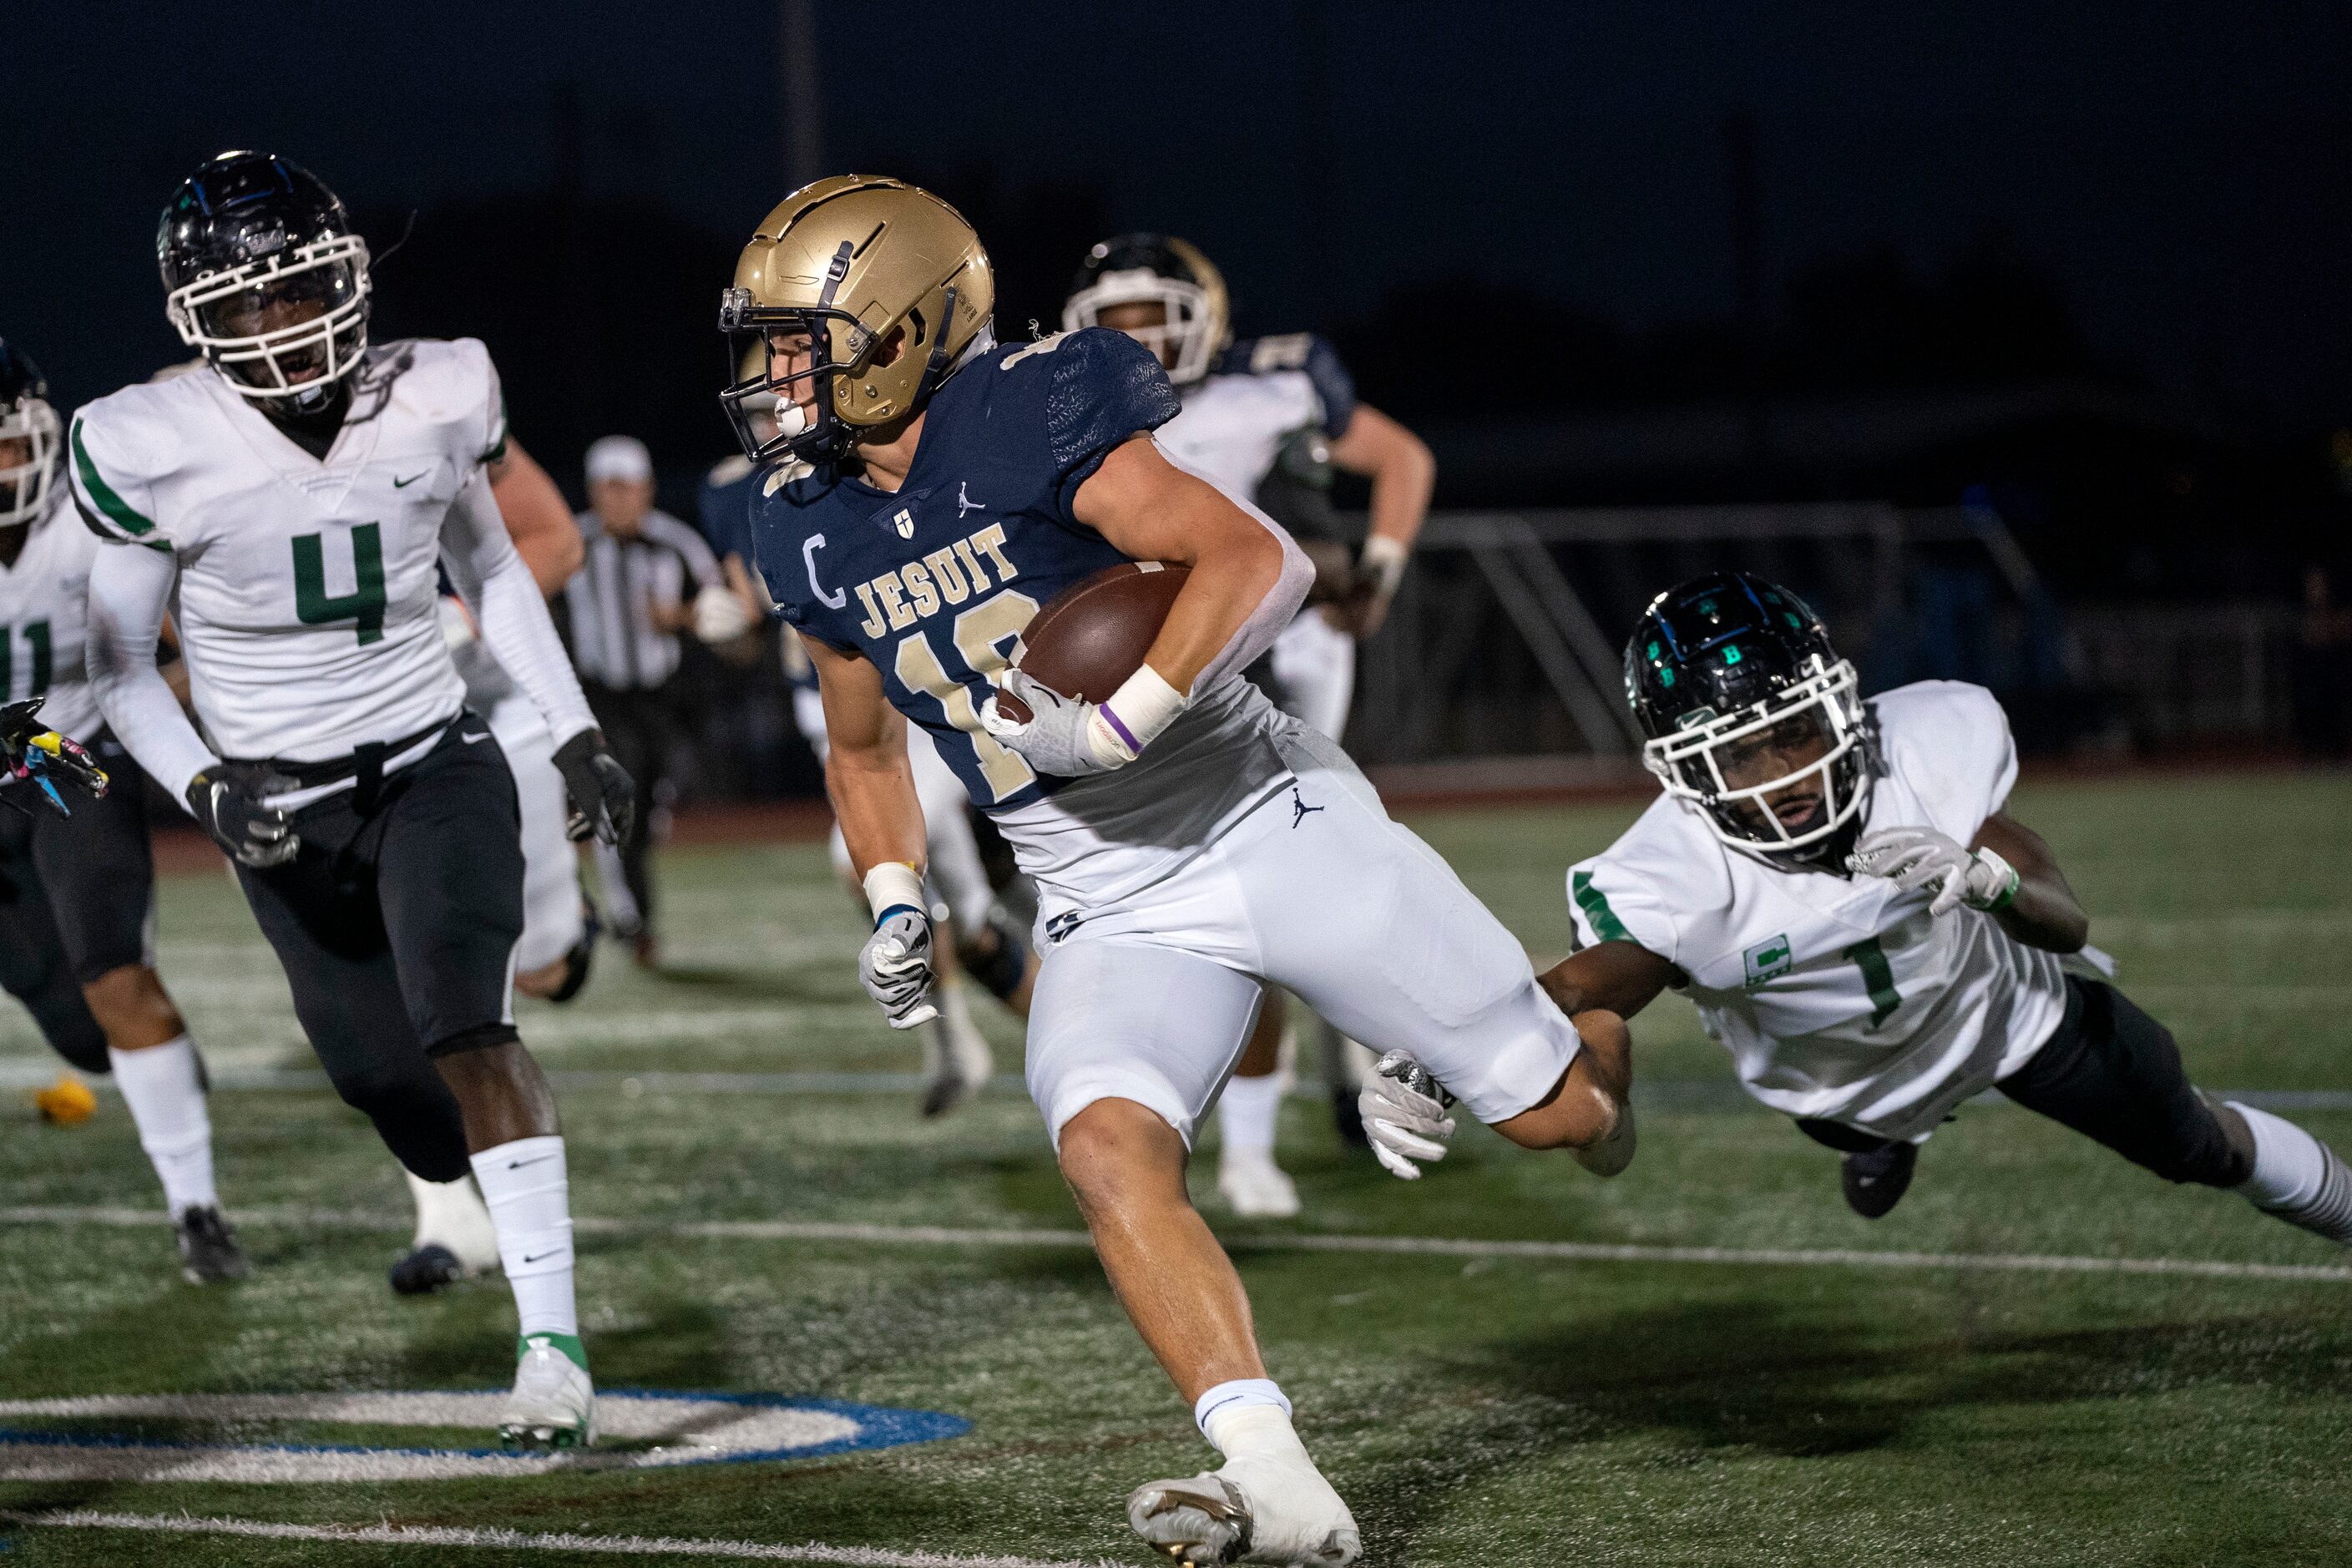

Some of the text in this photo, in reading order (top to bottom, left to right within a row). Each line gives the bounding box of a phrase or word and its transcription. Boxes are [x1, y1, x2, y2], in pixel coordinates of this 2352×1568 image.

[291, 521, 387, 647] 4
[802, 533, 847, 609] C
[853, 522, 1019, 640] JESUIT
[1722, 645, 1742, 665] B
[1842, 935, 1903, 1029] 1
